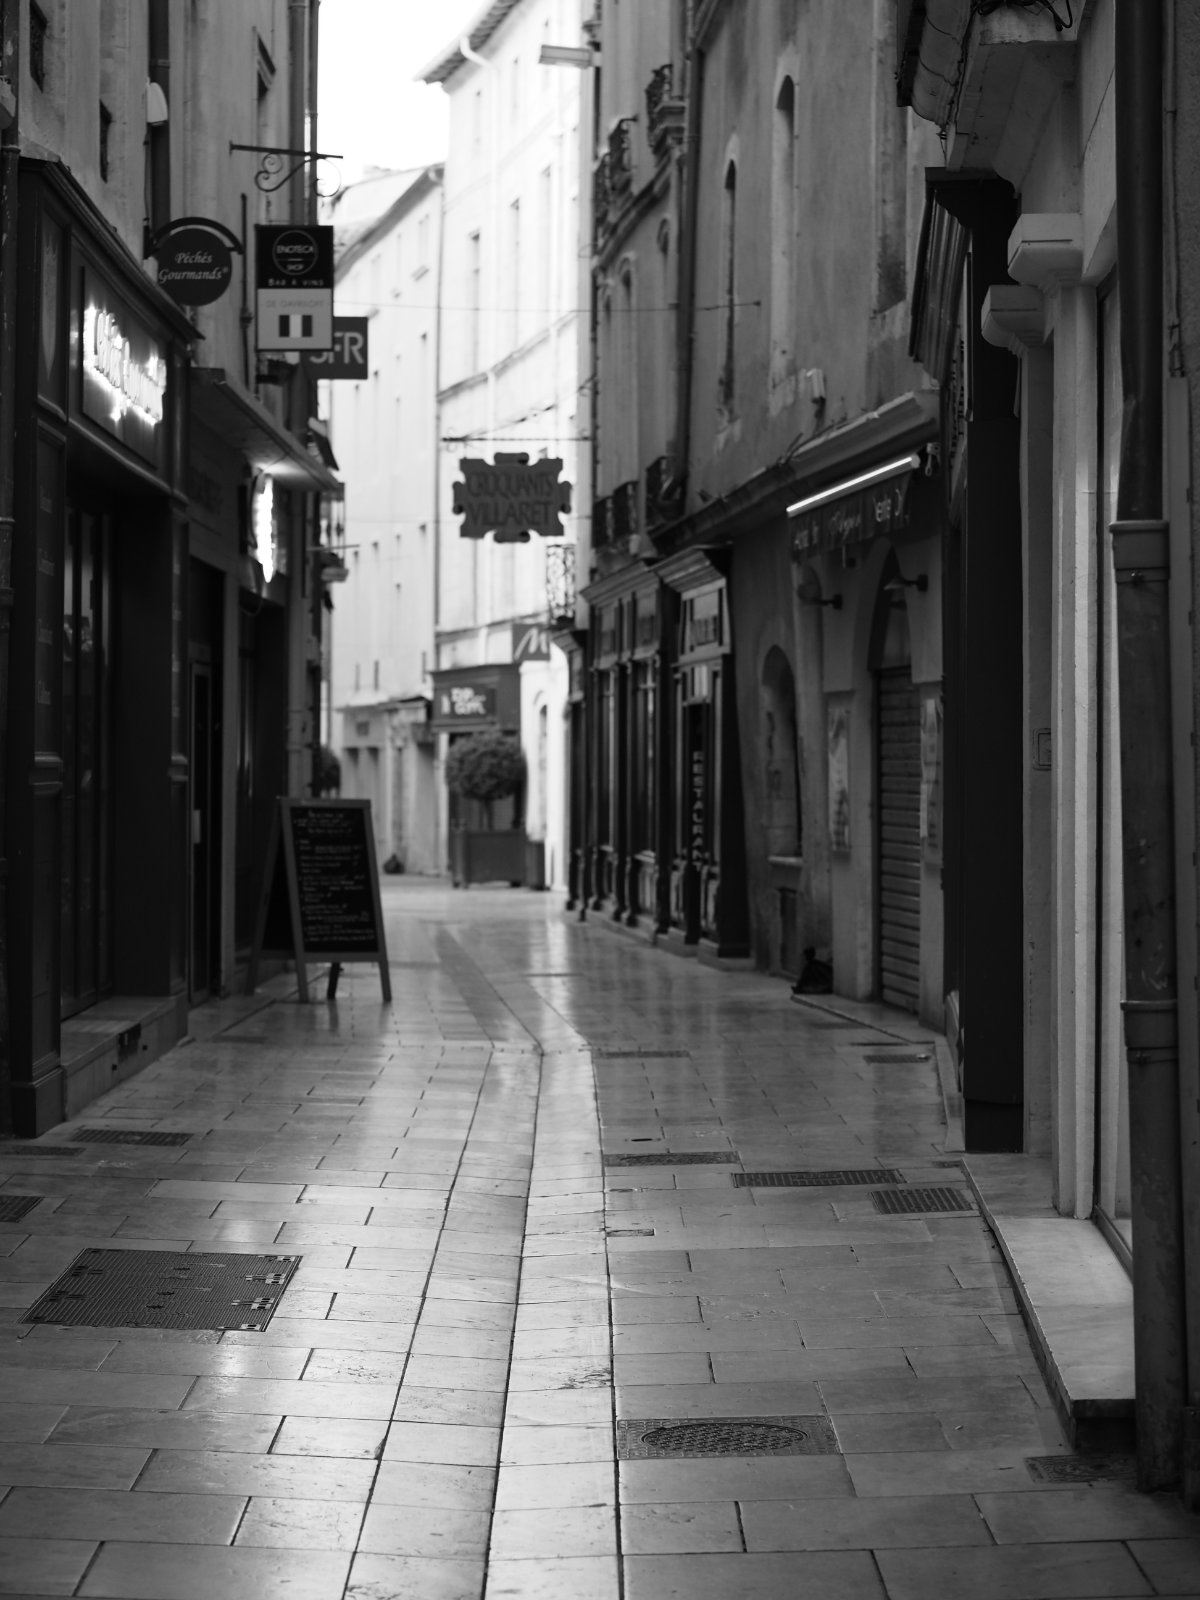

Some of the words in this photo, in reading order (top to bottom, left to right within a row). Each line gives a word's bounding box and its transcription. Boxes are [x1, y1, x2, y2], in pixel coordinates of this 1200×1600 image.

[175, 250, 213, 264] Péchés
[159, 267, 222, 284] Gourmands
[467, 470, 554, 498] CROQUANTS
[467, 500, 553, 526] VILLARET
[692, 751, 704, 872] RESTAURANT
